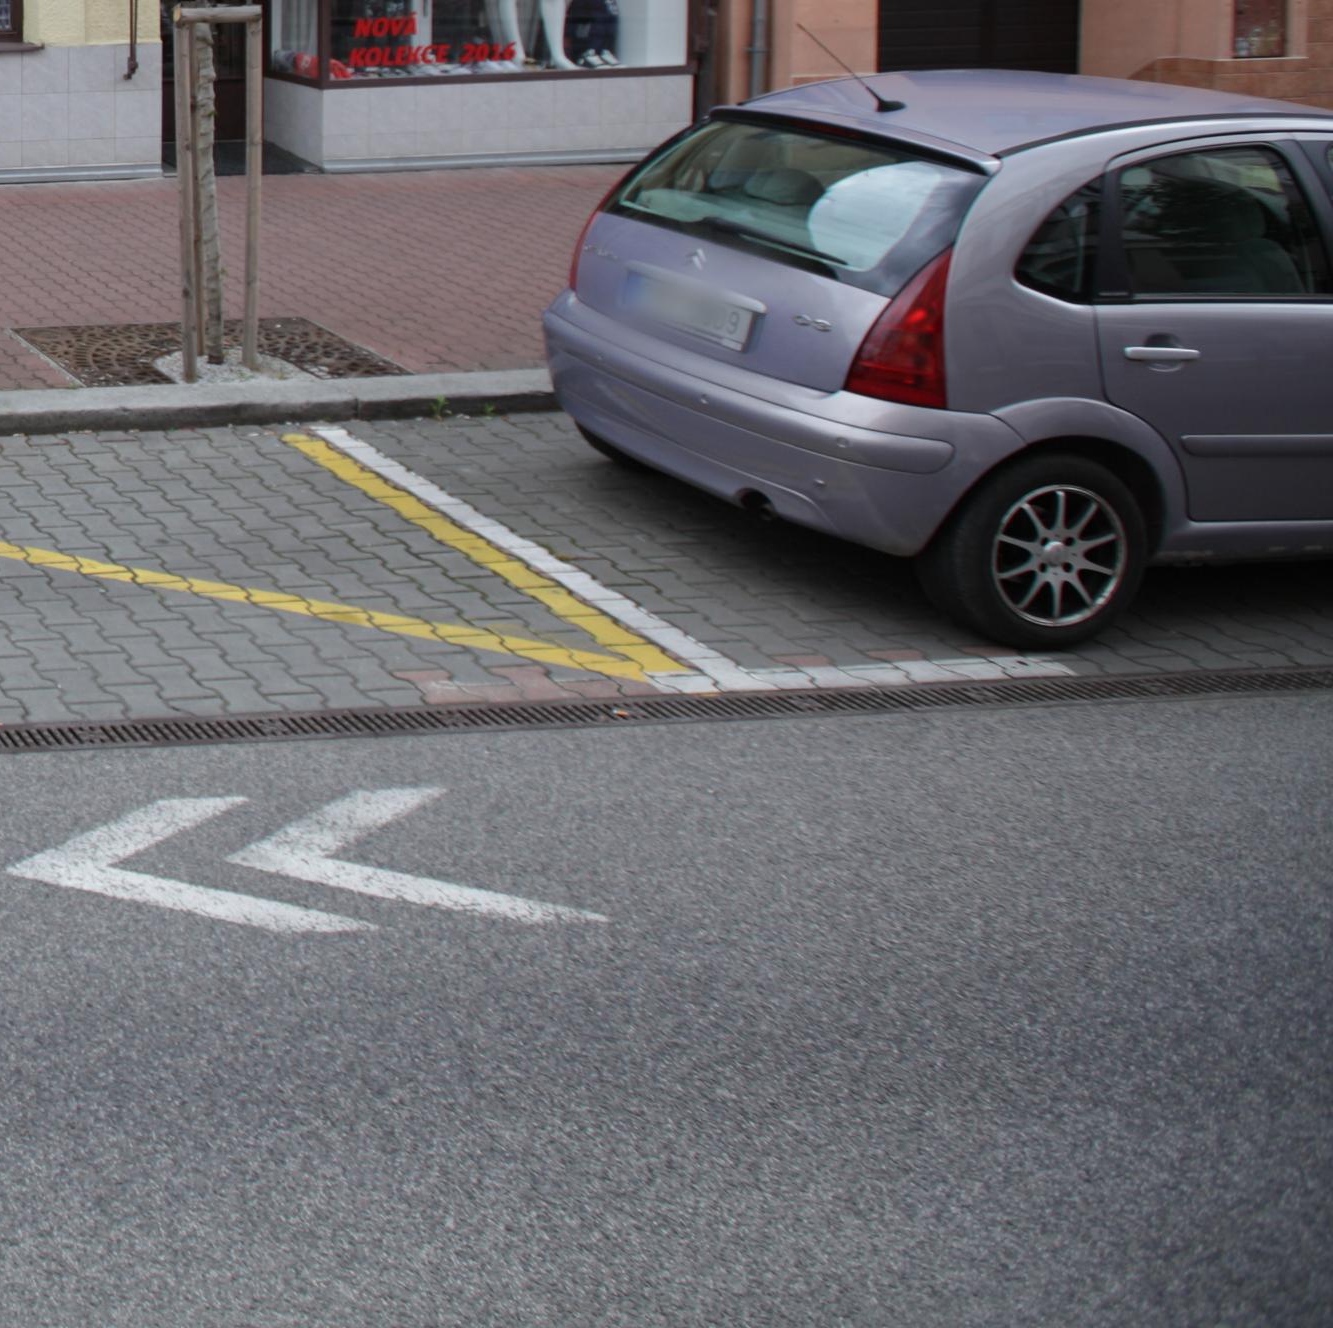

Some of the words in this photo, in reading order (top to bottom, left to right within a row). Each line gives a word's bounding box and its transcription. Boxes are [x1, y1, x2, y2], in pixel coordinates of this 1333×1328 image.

[354, 12, 417, 38] NOVÁ
[348, 43, 451, 68] KOLEKCE
[460, 41, 517, 65] 2016
